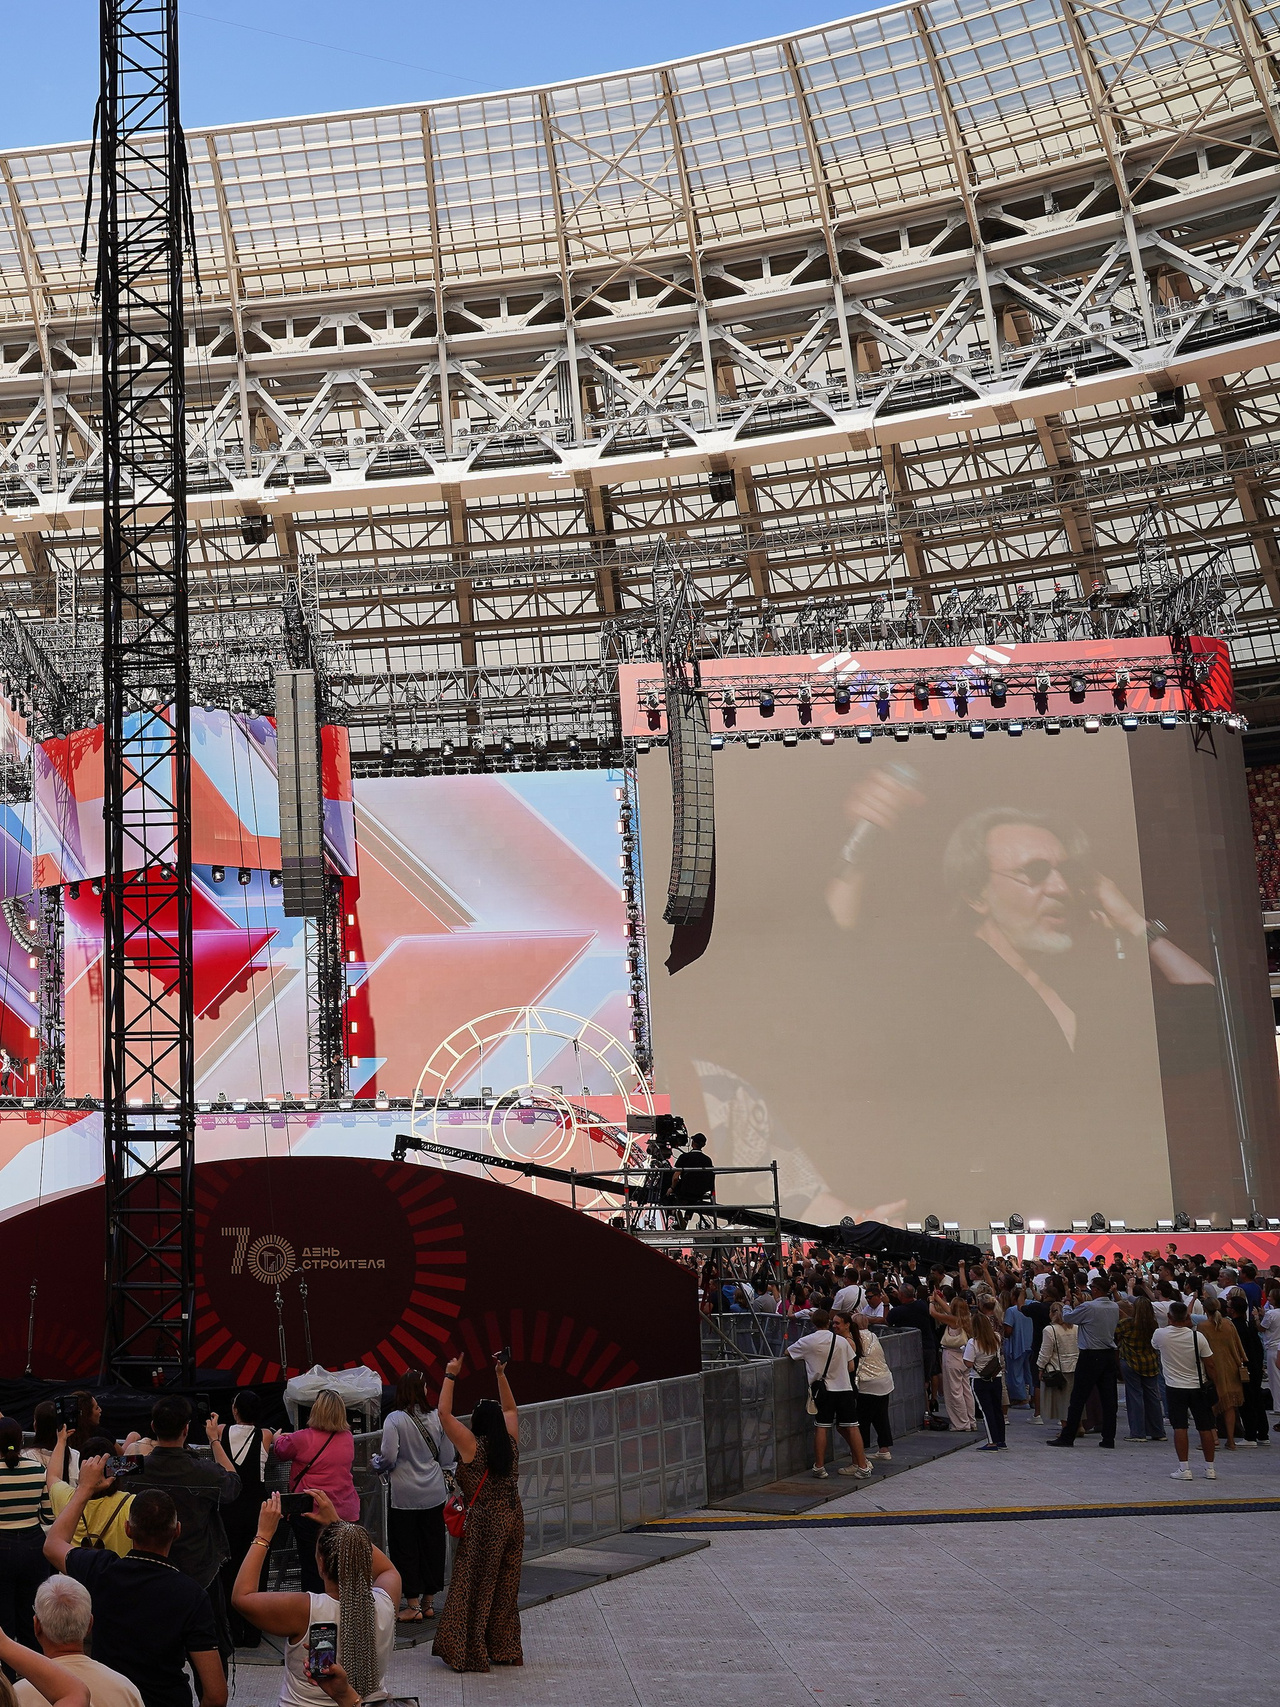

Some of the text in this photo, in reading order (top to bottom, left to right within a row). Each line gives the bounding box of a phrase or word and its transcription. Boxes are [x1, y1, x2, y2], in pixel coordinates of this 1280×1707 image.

[222, 1227, 296, 1284] 70
[302, 1247, 340, 1257] ДЕНЬ
[302, 1259, 386, 1269] СТРОИТЕЛЯ
